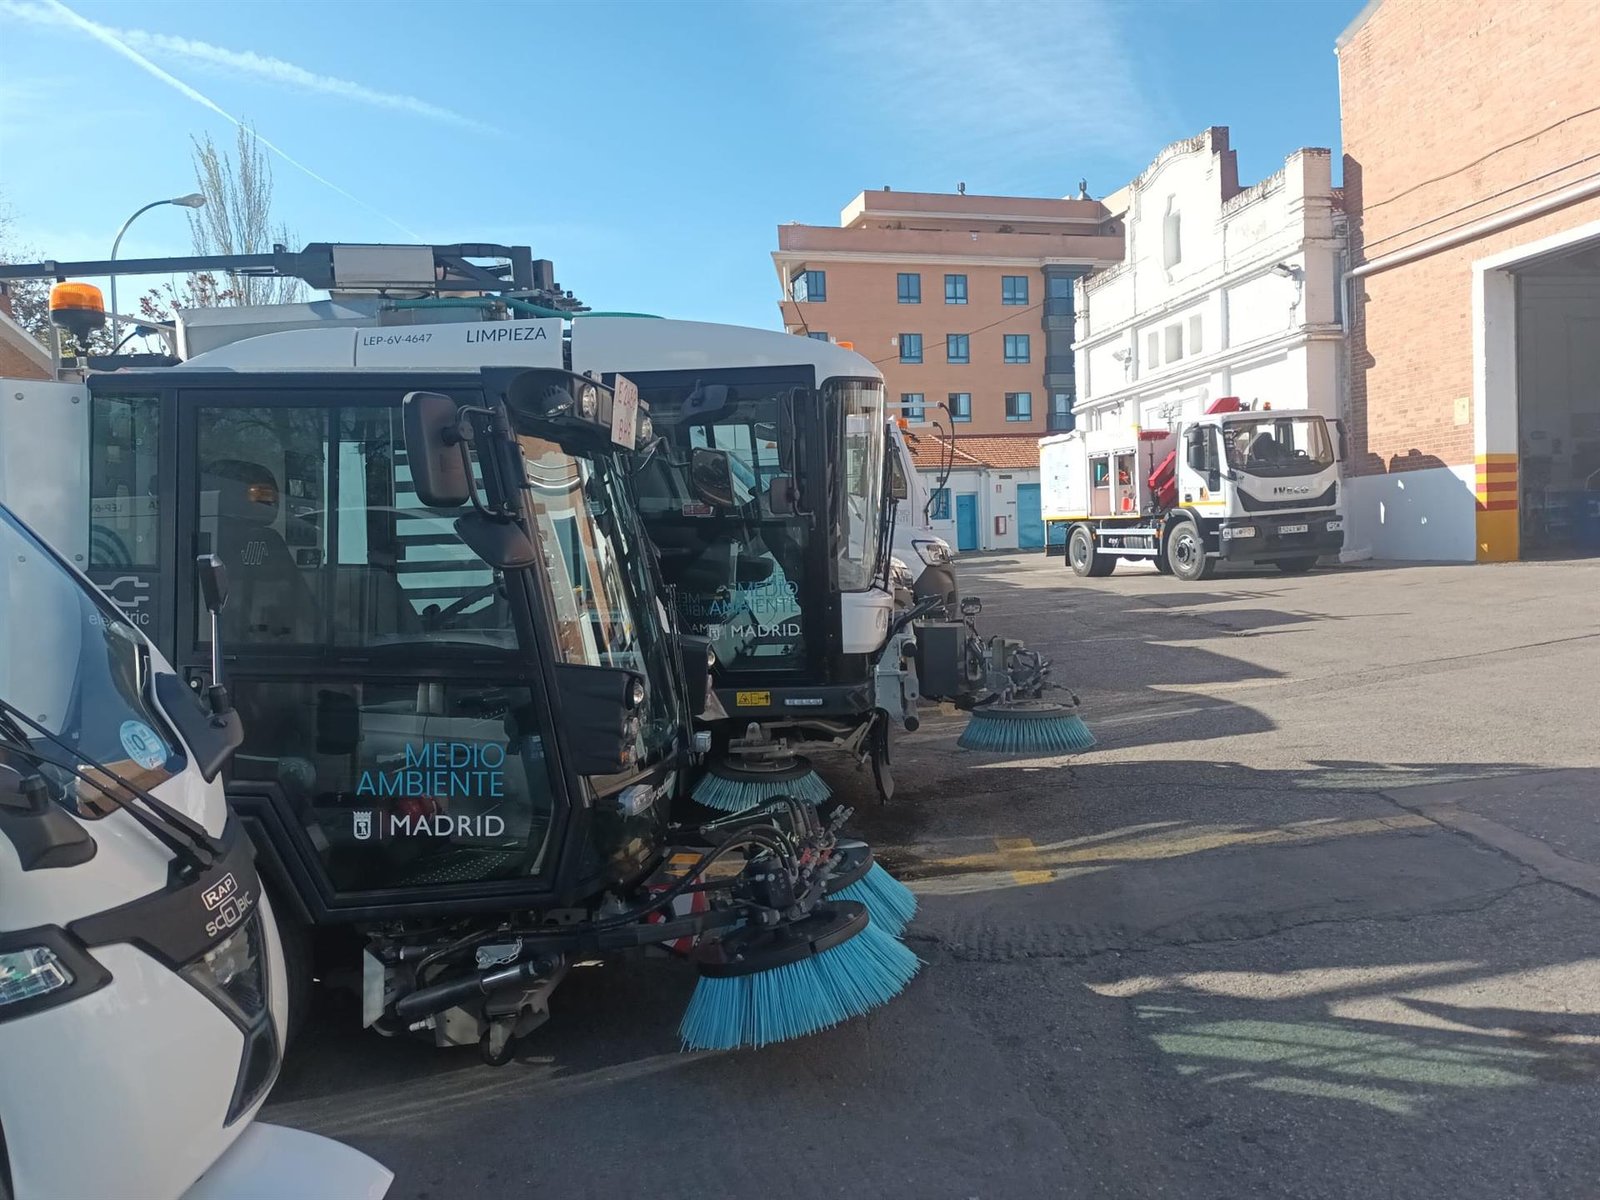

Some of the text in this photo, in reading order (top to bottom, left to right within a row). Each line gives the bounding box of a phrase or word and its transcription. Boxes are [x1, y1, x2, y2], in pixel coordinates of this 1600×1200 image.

[363, 333, 433, 346] LEP-6V-4647
[466, 326, 547, 343] LIMPIEZA
[1273, 486, 1310, 495] IVECO
[736, 581, 799, 597] MEDIO
[88, 609, 150, 625] eletric
[731, 623, 801, 638] MADRID
[405, 742, 505, 769] MEDIO
[356, 771, 505, 797] AMBIENTE
[390, 814, 505, 837] MADRID
[205, 878, 232, 905] RAP
